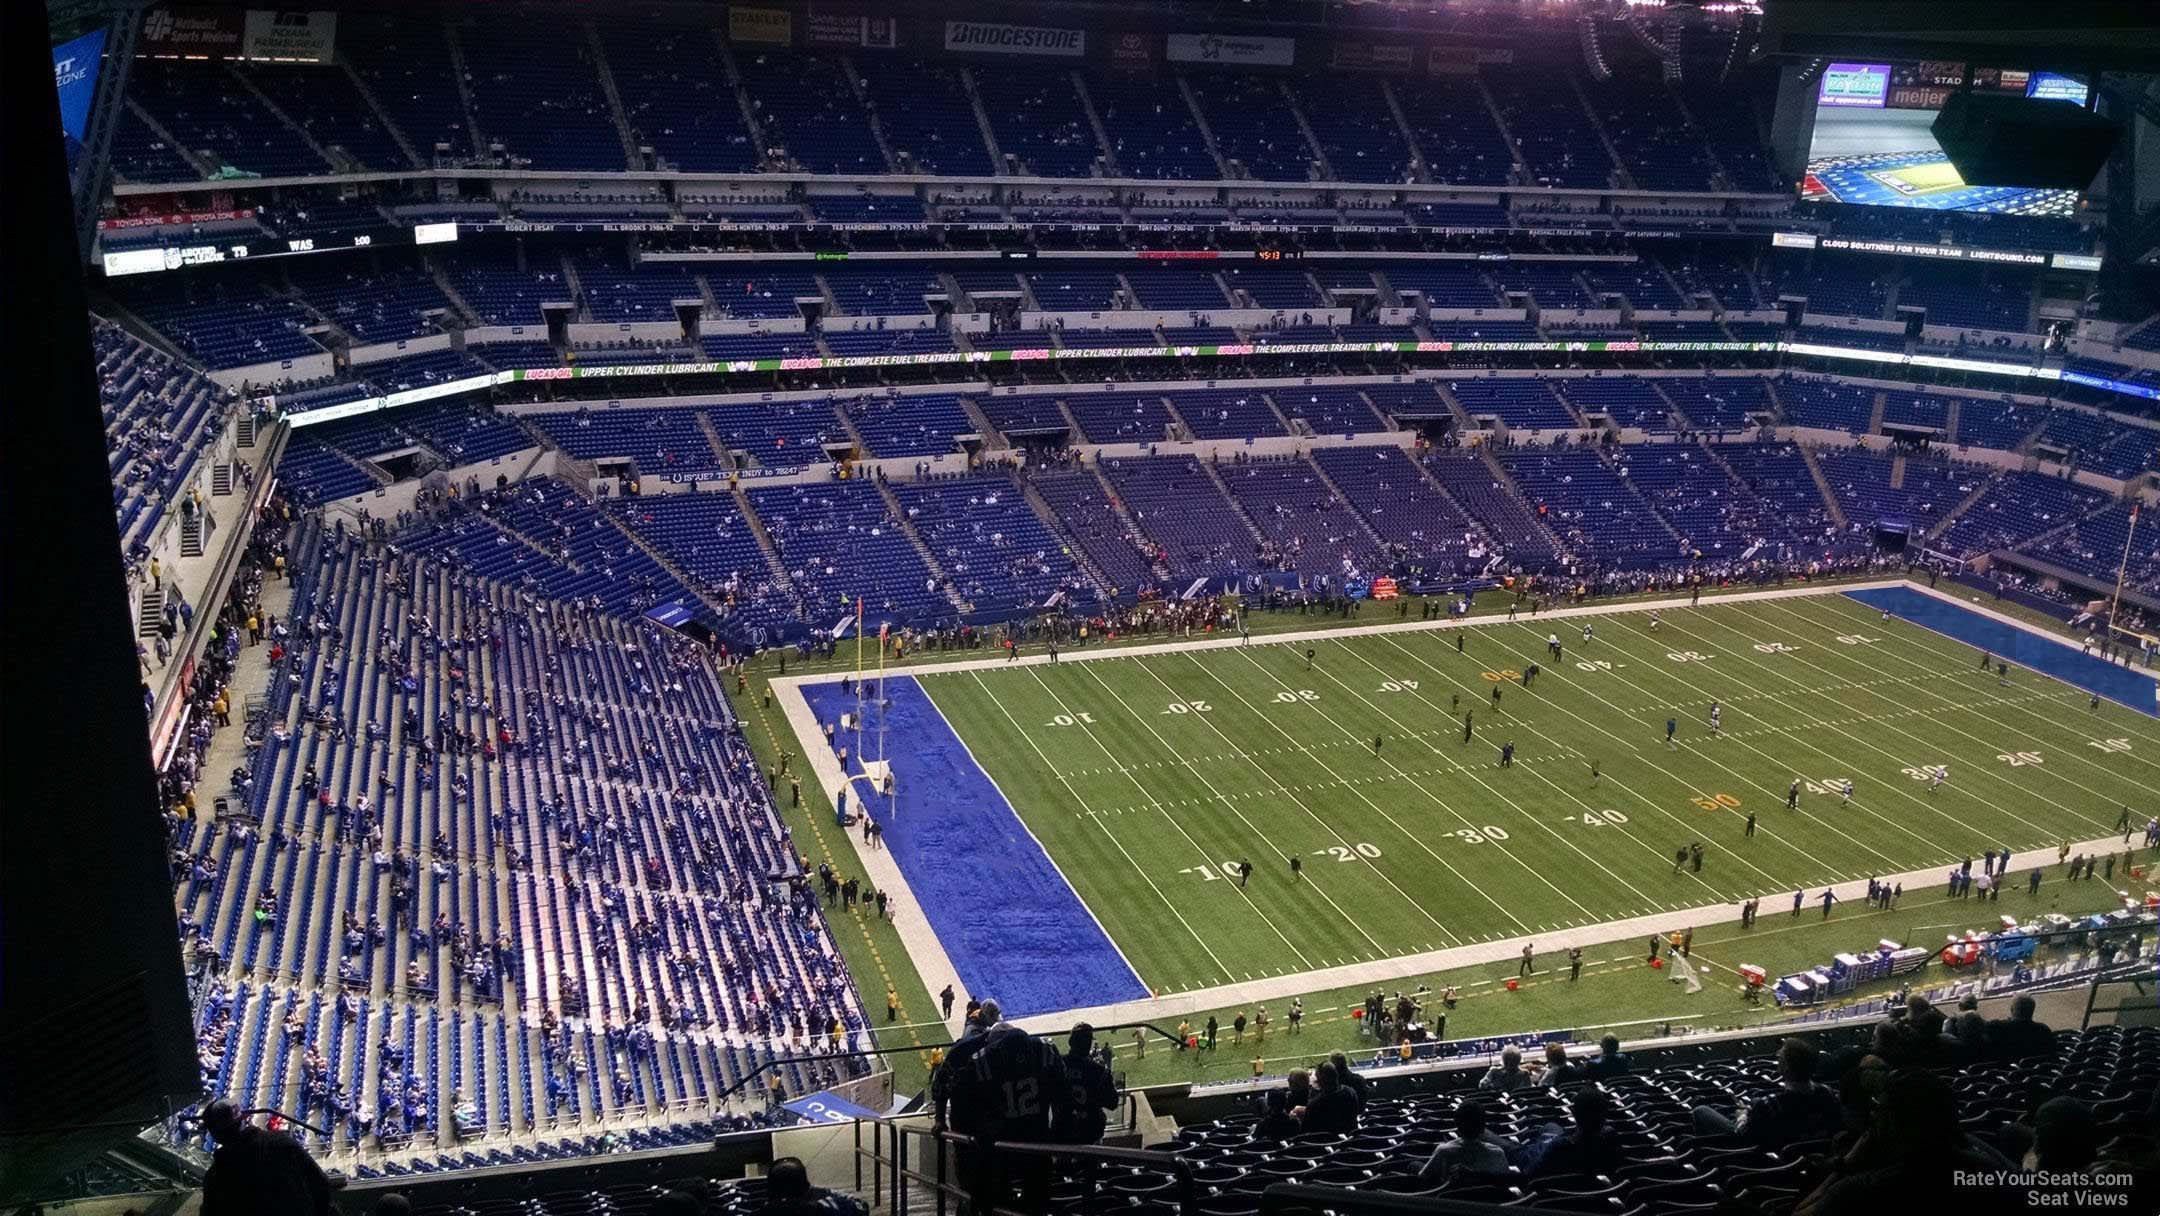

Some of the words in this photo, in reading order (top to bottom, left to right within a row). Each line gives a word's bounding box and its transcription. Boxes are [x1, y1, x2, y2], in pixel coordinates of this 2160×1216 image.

[952, 23, 1081, 48] BRIDGESTONE
[56, 67, 88, 87] ZONE
[1895, 88, 1947, 107] meijer
[115, 218, 142, 227] TOYOTA
[143, 216, 164, 226] ZONE
[190, 213, 215, 221] TOYOTA
[216, 211, 235, 220] ZONE
[289, 239, 313, 252] WAS
[354, 236, 371, 246] 1:00
[232, 246, 248, 258] TB
[1258, 251, 1281, 261] 45:13
[1822, 240, 1849, 249] CLOUD
[1850, 241, 1895, 252] SOLUTIONS
[1896, 245, 1914, 253] FOR
[1914, 246, 1937, 255] YOUR
[1938, 248, 1963, 257] TEAM
[1969, 251, 2045, 264] LIGHTBOUND.COM
[1055, 349, 1083, 359] UPPER
[1083, 349, 1122, 358] CYLINDER
[1123, 348, 1168, 357] LUBRICANT
[1255, 345, 1270, 353] THE
[1270, 344, 1309, 353] COMPLETE
[1309, 344, 1329, 352] FUEL
[1330, 343, 1372, 351] TREATMENT
[1457, 343, 1482, 351] UPPER
[1482, 343, 1519, 351] CYLINDER
[1519, 343, 1561, 351] LUBRICANT
[1640, 343, 1654, 351] THE
[1654, 343, 1691, 351] COMPLETE
[1691, 343, 1710, 351] FUEL
[1710, 343, 1750, 351] TREATMENT
[826, 358, 842, 368] THE
[843, 356, 890, 366] COMPLETE
[891, 355, 913, 364] FUEL
[914, 353, 961, 363] TREATMENT
[524, 368, 556, 380] LUCAS
[580, 366, 614, 377] UPPER
[616, 365, 664, 376] CYLINDER
[665, 363, 720, 374] LUBRICANT
[741, 469, 762, 478] INDY
[1480, 668, 1523, 683] 50
[1383, 677, 1419, 694] 40
[1277, 689, 1321, 705] 30
[1168, 699, 1212, 715] 20
[1054, 711, 1097, 727] 10
[2088, 737, 2132, 752] 10
[1997, 750, 2043, 767] 20
[1805, 777, 1850, 796] 40
[1692, 792, 1742, 811] 50
[1582, 808, 1629, 829] 40
[1459, 825, 1510, 845] 30
[1327, 842, 1382, 863] 20
[1199, 860, 1243, 883] 10
[1001, 1077, 1041, 1119] 12
